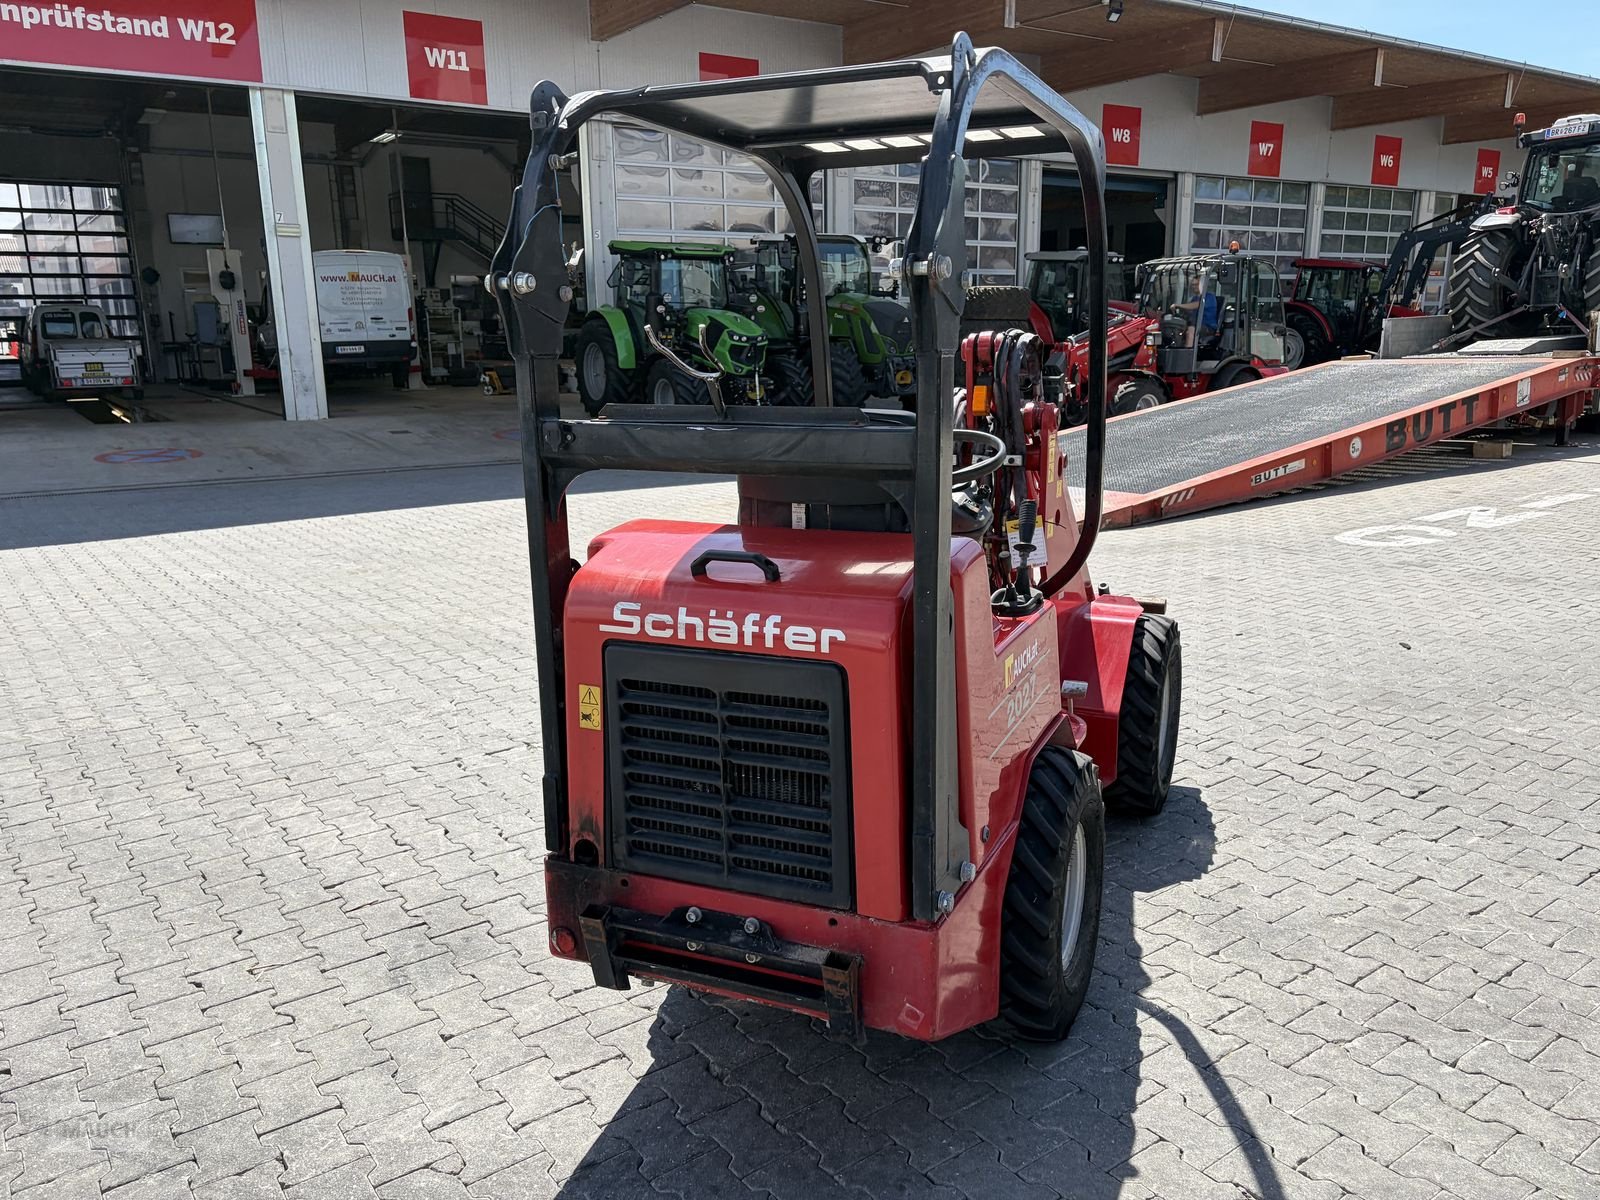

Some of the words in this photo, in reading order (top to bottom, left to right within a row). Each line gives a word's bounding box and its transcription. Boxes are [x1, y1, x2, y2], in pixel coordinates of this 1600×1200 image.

[0, 3, 169, 38] nprüfstand
[177, 17, 236, 45] W12
[424, 46, 470, 72] W11
[1112, 127, 1131, 144] W8
[1258, 142, 1274, 157] W7
[1380, 154, 1394, 168] W6
[1481, 166, 1493, 178] W5
[276, 212, 283, 222] 7
[1385, 394, 1480, 453] BUTT
[1254, 464, 1289, 484] BUTT
[599, 602, 846, 653] Schäffer
